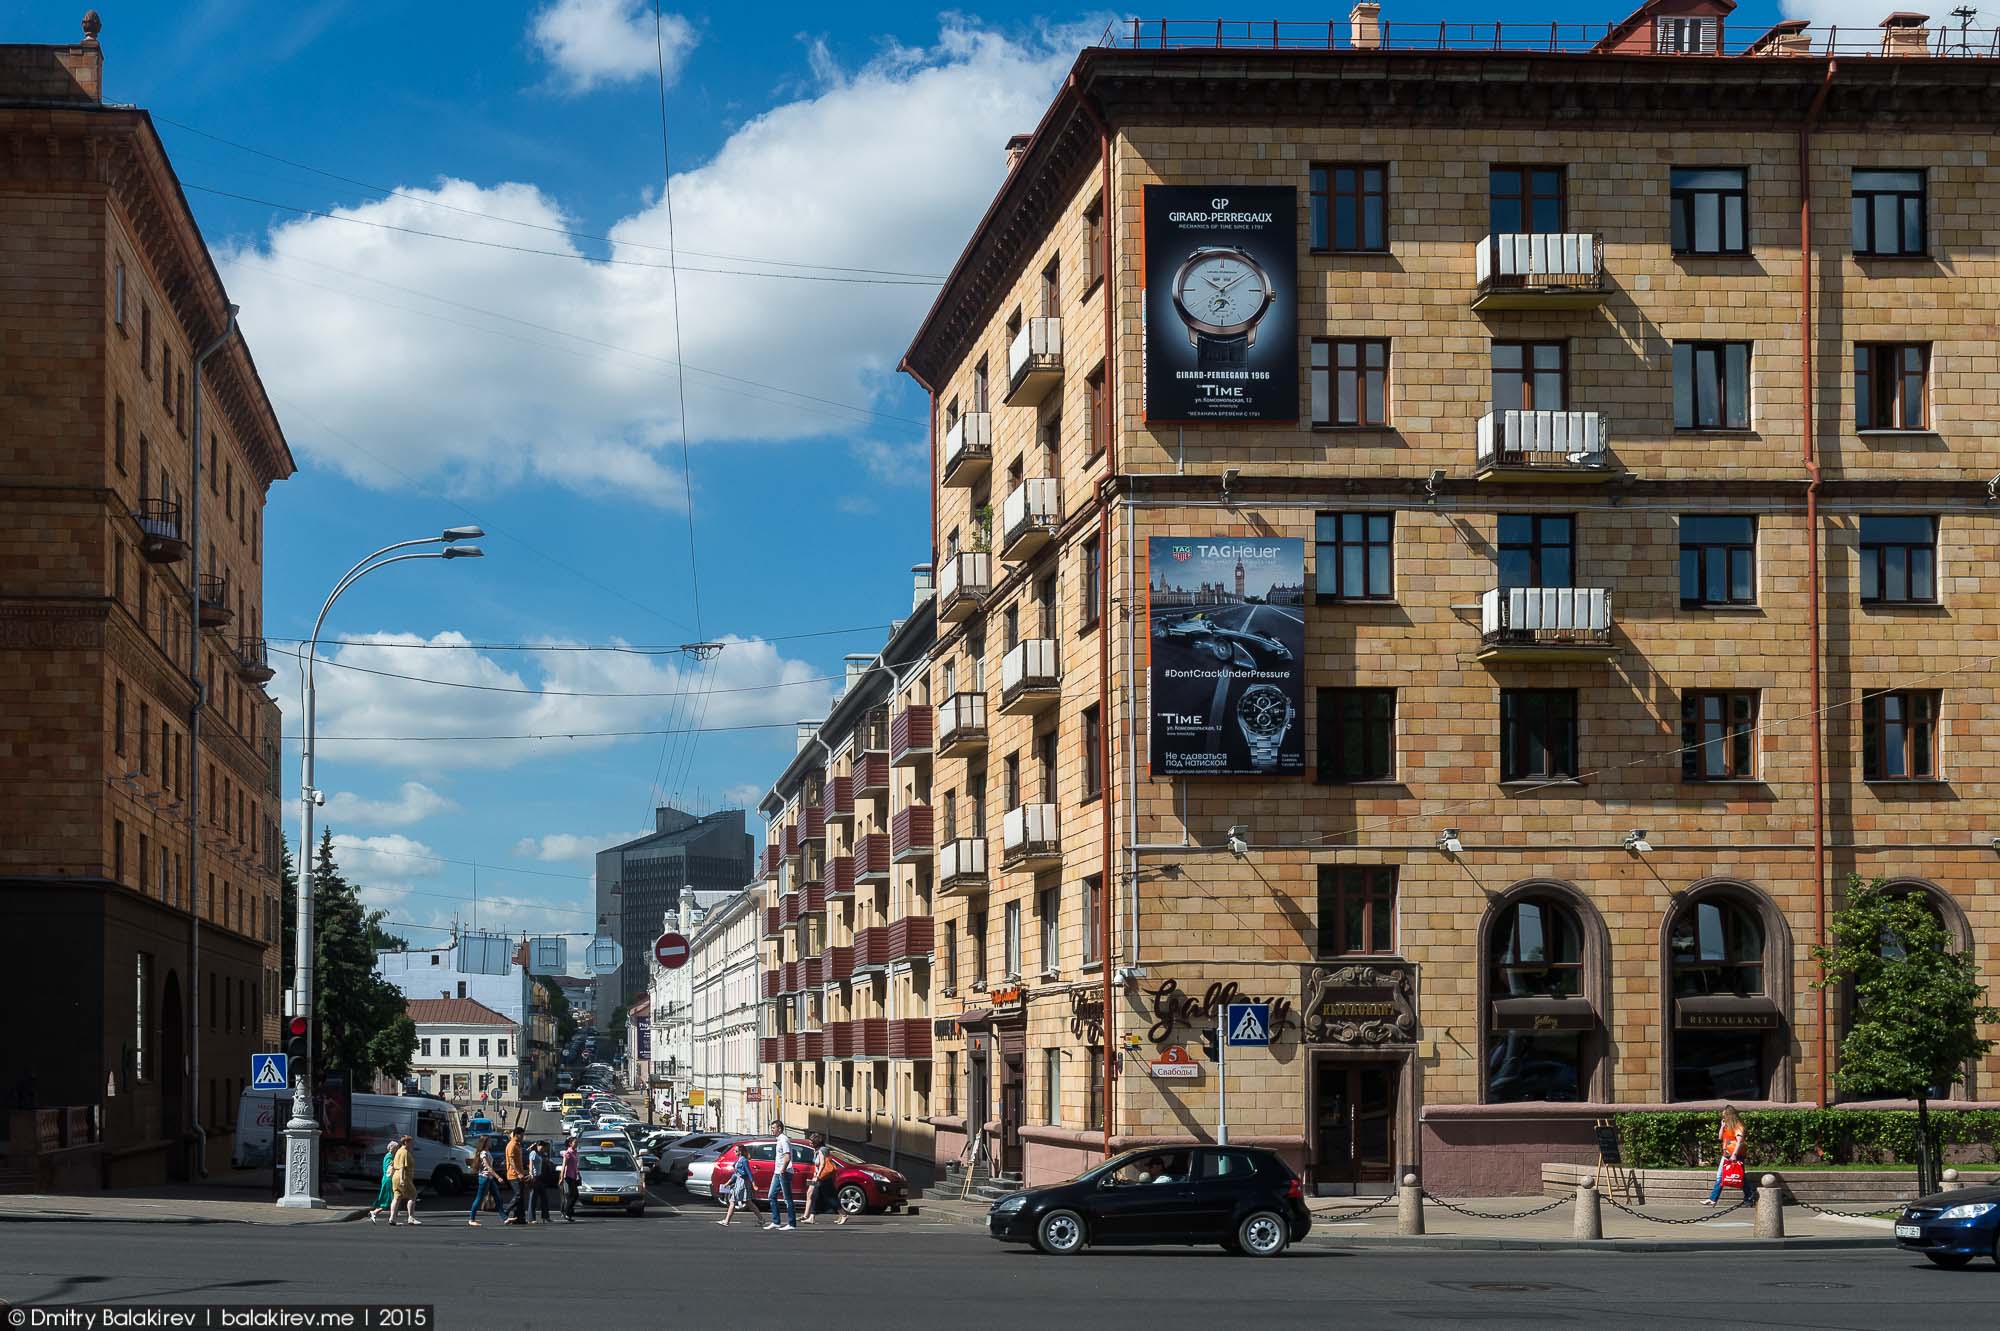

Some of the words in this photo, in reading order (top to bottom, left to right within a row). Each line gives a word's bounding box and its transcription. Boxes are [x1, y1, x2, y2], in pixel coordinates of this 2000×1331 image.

[1211, 198, 1229, 210] GP
[1168, 211, 1273, 223] GIRARD-PERREGAUX
[1176, 371, 1249, 379] GIRARD-PERREGAUX
[1251, 371, 1270, 380] 1966
[1165, 669, 1290, 679] #DontCrackUnderPressure
[1165, 752, 1178, 760] Не
[1180, 752, 1227, 761] сдаваться
[1690, 1015, 1768, 1025] RESTAURANT
[1168, 1048, 1178, 1062] 5
[1157, 1067, 1193, 1076] Свабоды
